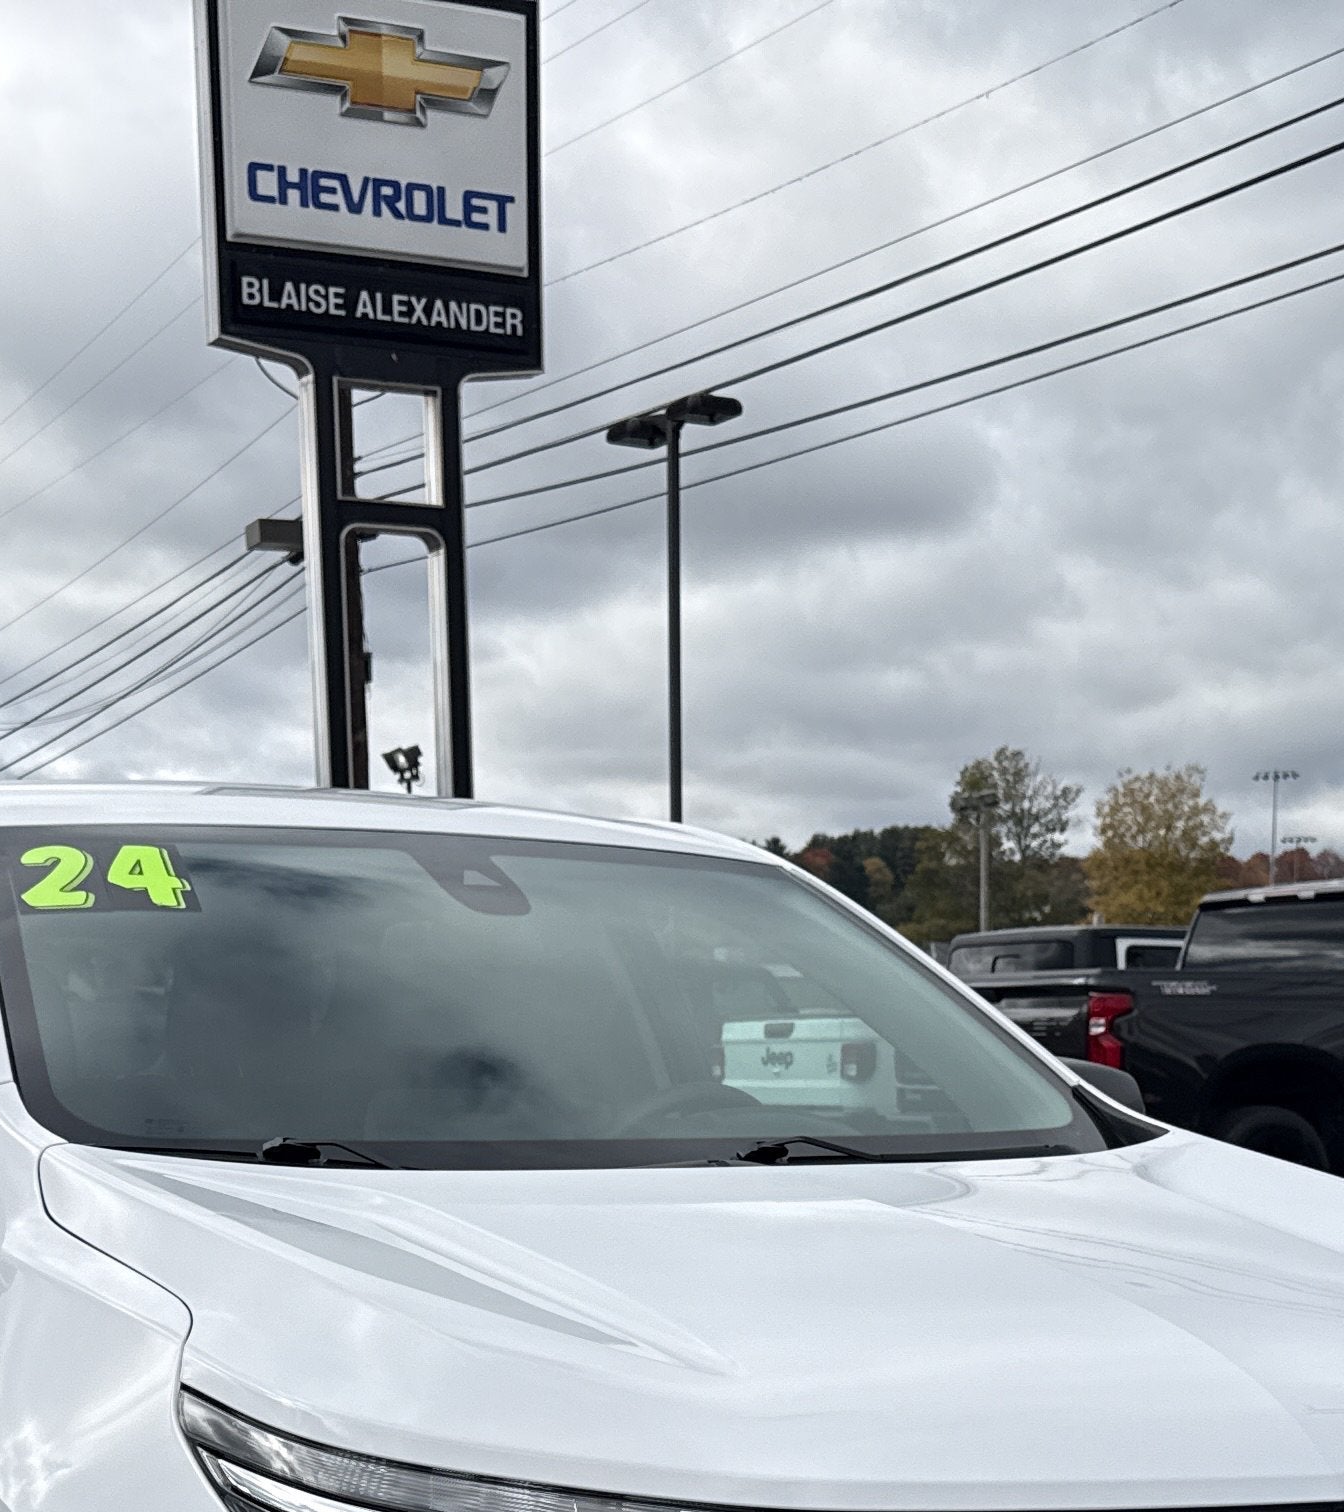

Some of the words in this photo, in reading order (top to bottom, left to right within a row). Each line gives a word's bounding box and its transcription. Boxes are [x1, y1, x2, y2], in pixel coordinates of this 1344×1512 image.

[246, 161, 516, 234] CHEVROLET
[240, 275, 347, 317] BLAISE
[355, 289, 524, 337] ALEXANDER
[19, 845, 192, 910] 24
[761, 1046, 793, 1070] Jeep
